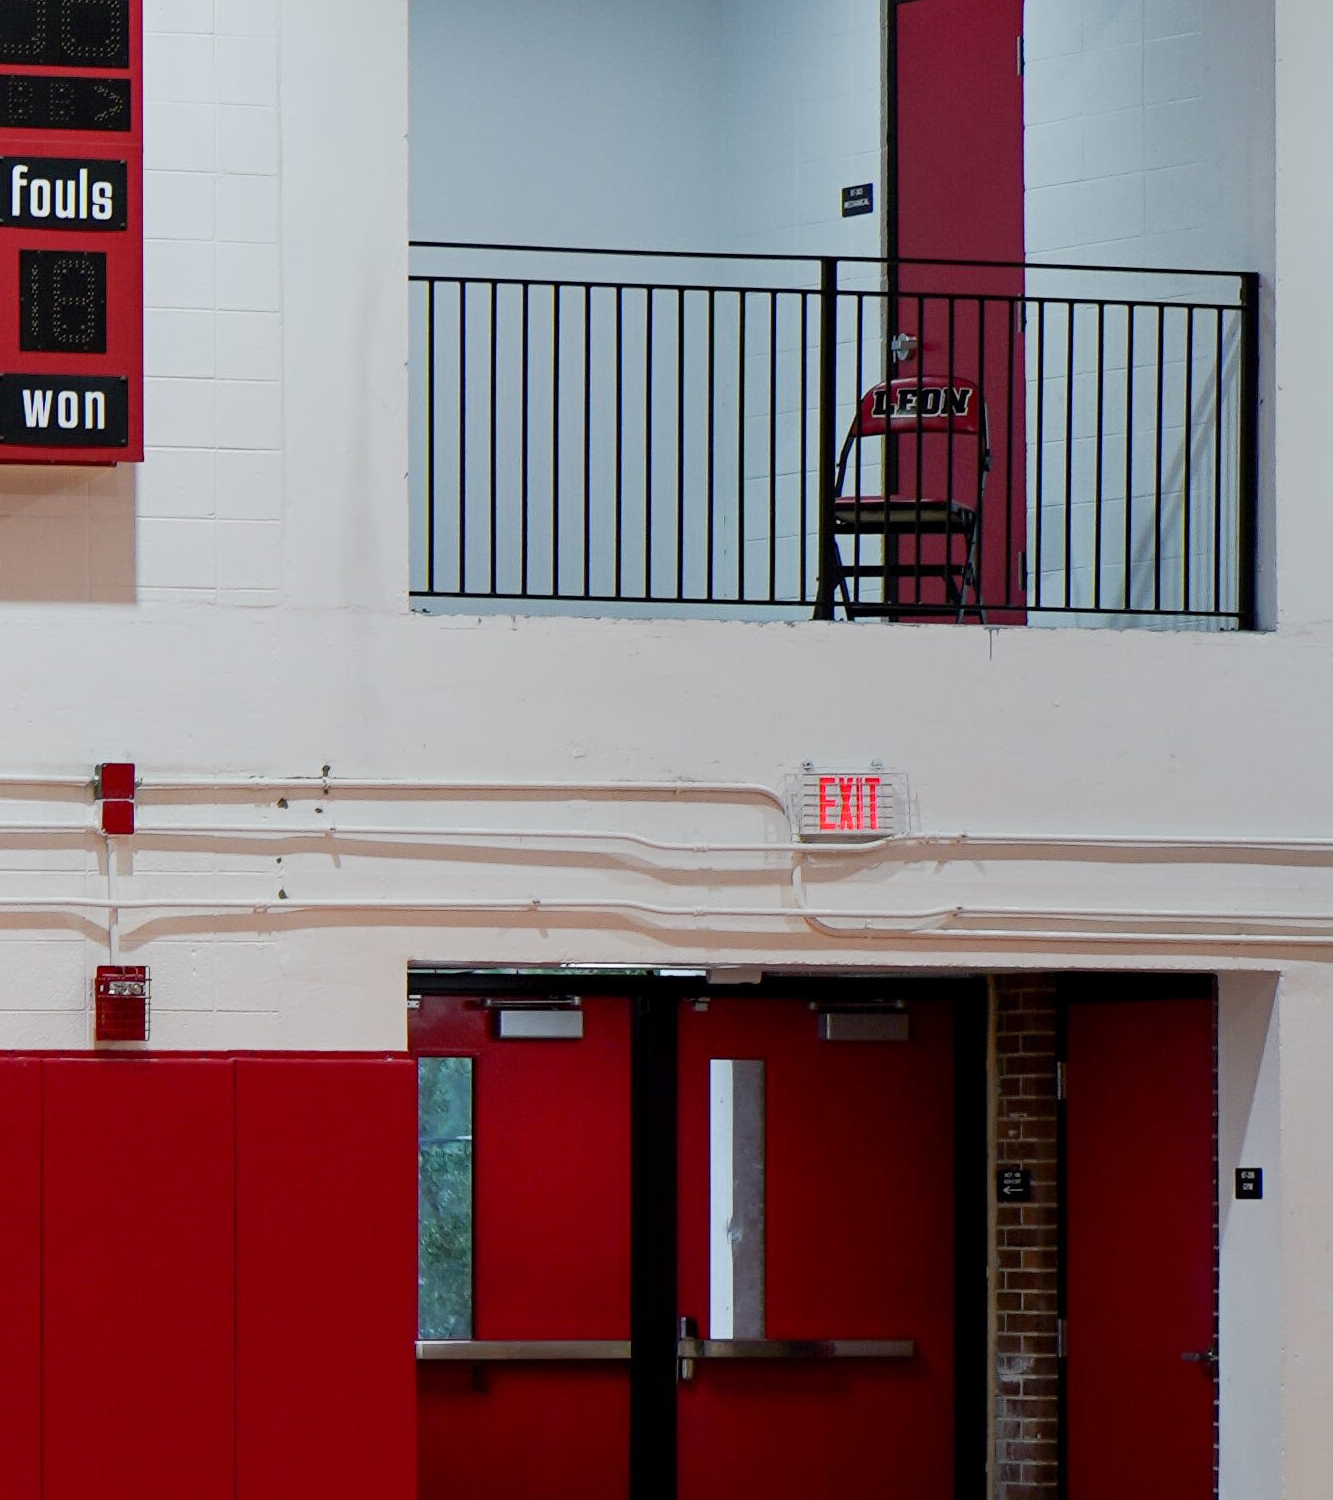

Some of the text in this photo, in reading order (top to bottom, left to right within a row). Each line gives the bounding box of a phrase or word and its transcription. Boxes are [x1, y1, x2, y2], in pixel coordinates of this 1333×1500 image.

[11, 164, 114, 220] fouls
[22, 389, 107, 430] won
[871, 387, 973, 418] LEON
[819, 777, 880, 830] EXIT
